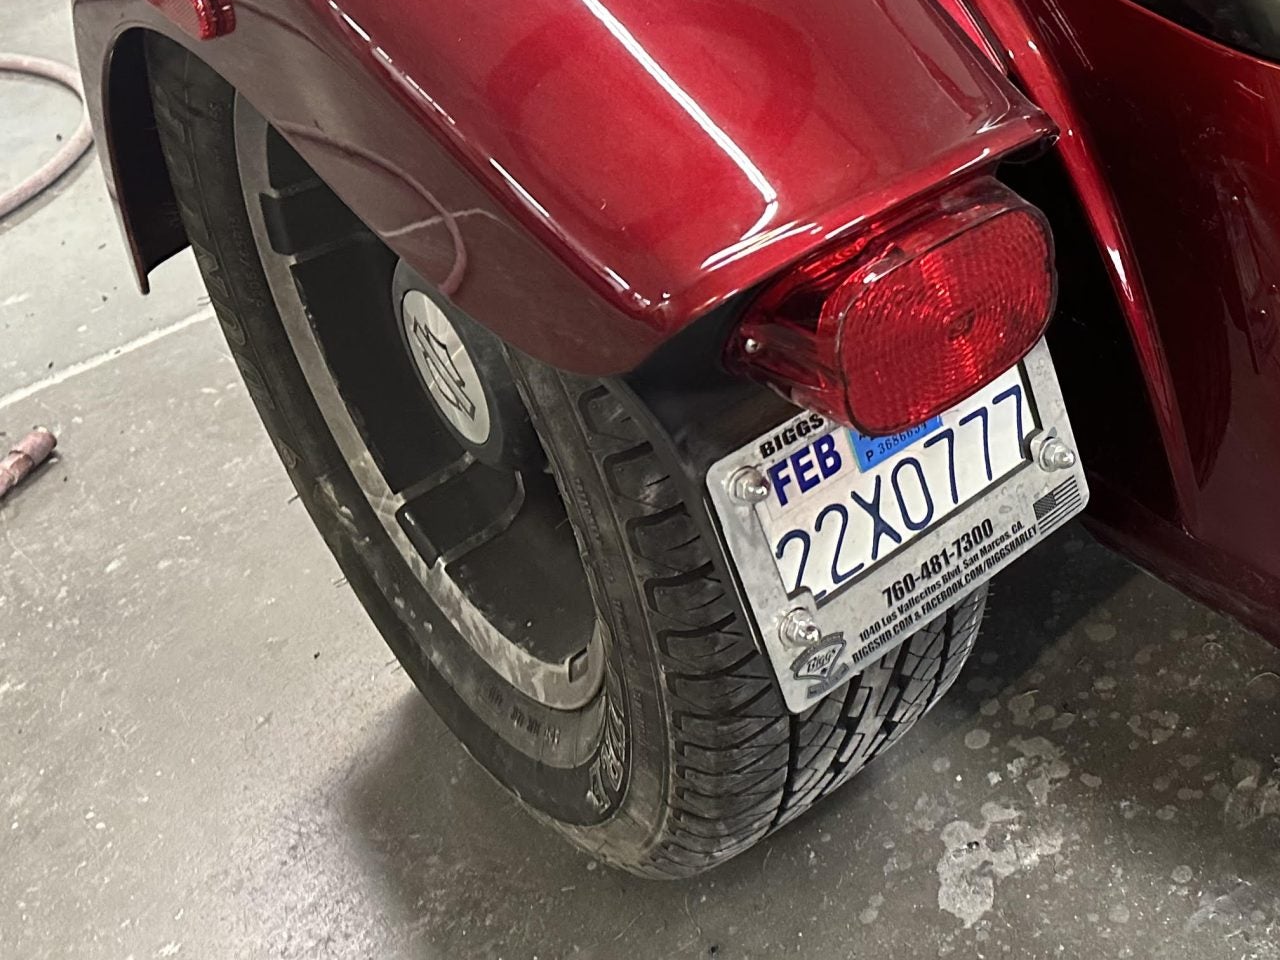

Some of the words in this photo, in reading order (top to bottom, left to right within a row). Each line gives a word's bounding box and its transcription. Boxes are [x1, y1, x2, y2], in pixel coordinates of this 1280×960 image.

[760, 413, 824, 459] BIGGS
[767, 434, 842, 507] FEB
[866, 449, 874, 462] P
[851, 614, 915, 664] BIGGSHD.COM
[914, 611, 923, 621] &
[920, 523, 1038, 616] FACEBOOK.COM/BIGGSHARLEY
[858, 621, 881, 642] 1040
[881, 610, 898, 626] Los
[897, 580, 942, 616] Vallecitos
[962, 552, 980, 569] San
[882, 518, 994, 608] 760-481-7300
